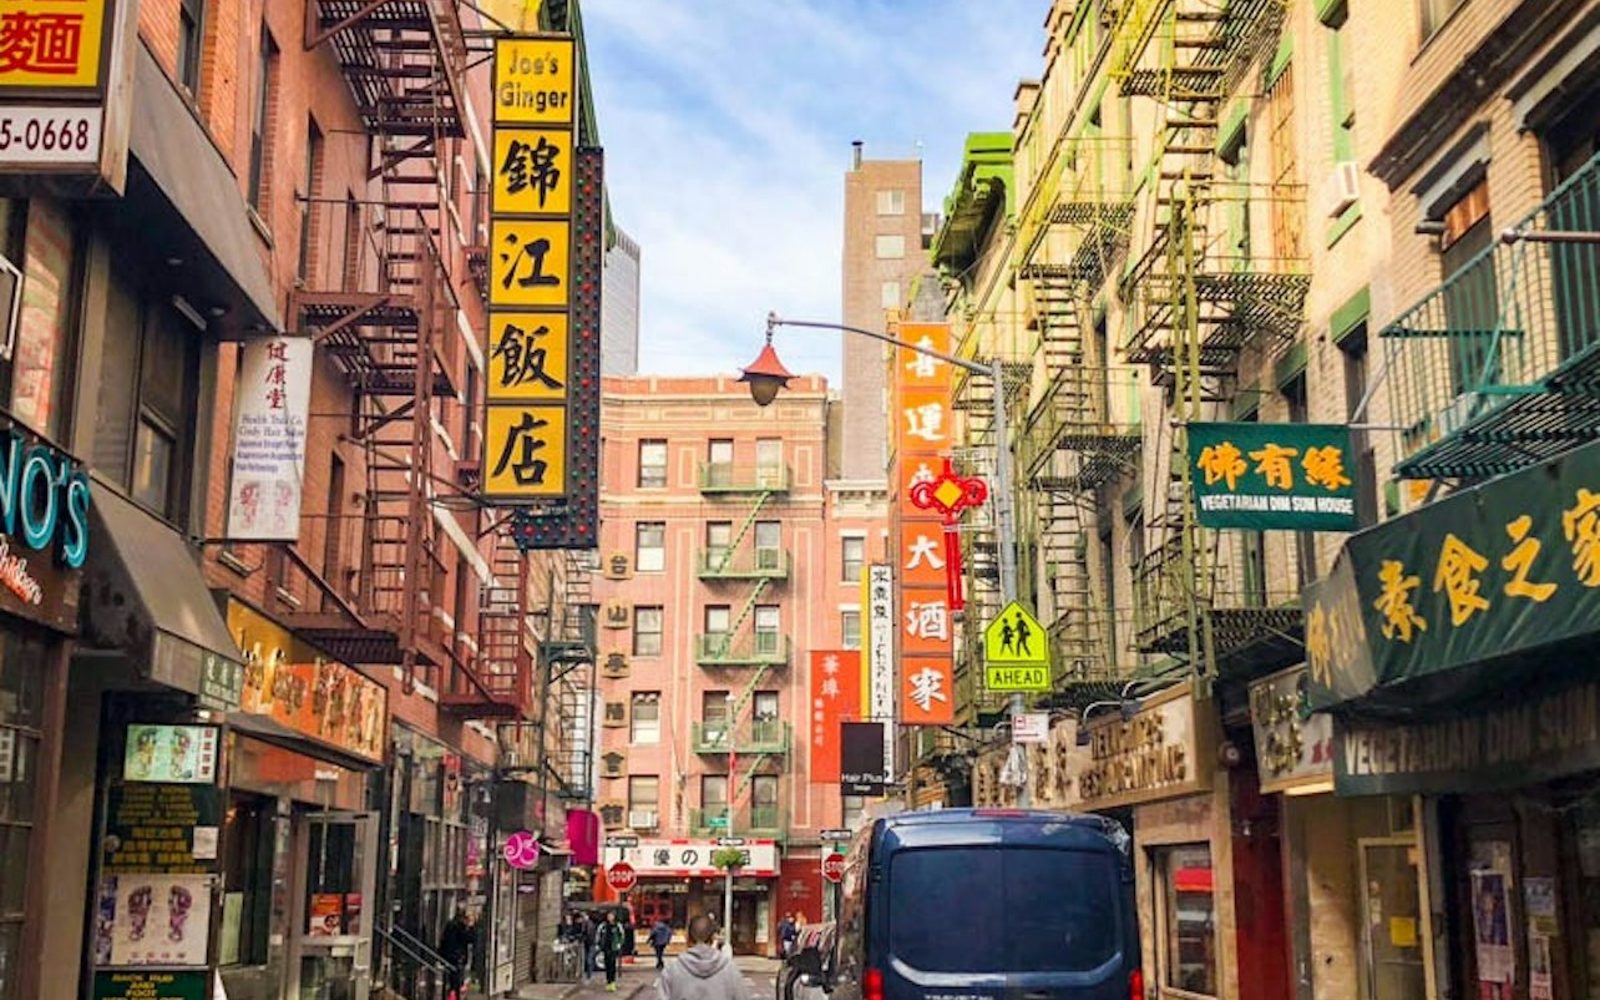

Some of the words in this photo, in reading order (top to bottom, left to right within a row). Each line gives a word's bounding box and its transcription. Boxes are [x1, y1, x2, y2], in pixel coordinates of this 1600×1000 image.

[509, 49, 559, 75] Joe's
[501, 82, 568, 113] Ginger
[490, 136, 564, 486] 錦江飯店
[1197, 441, 1352, 491] 佛有緣
[1200, 494, 1269, 511] VEGETARIAN
[1269, 495, 1291, 511] DIM
[1317, 497, 1354, 515] HOUSE
[993, 670, 1043, 685] AHEAD
[608, 870, 633, 883] STOP
[825, 861, 845, 873] STO
